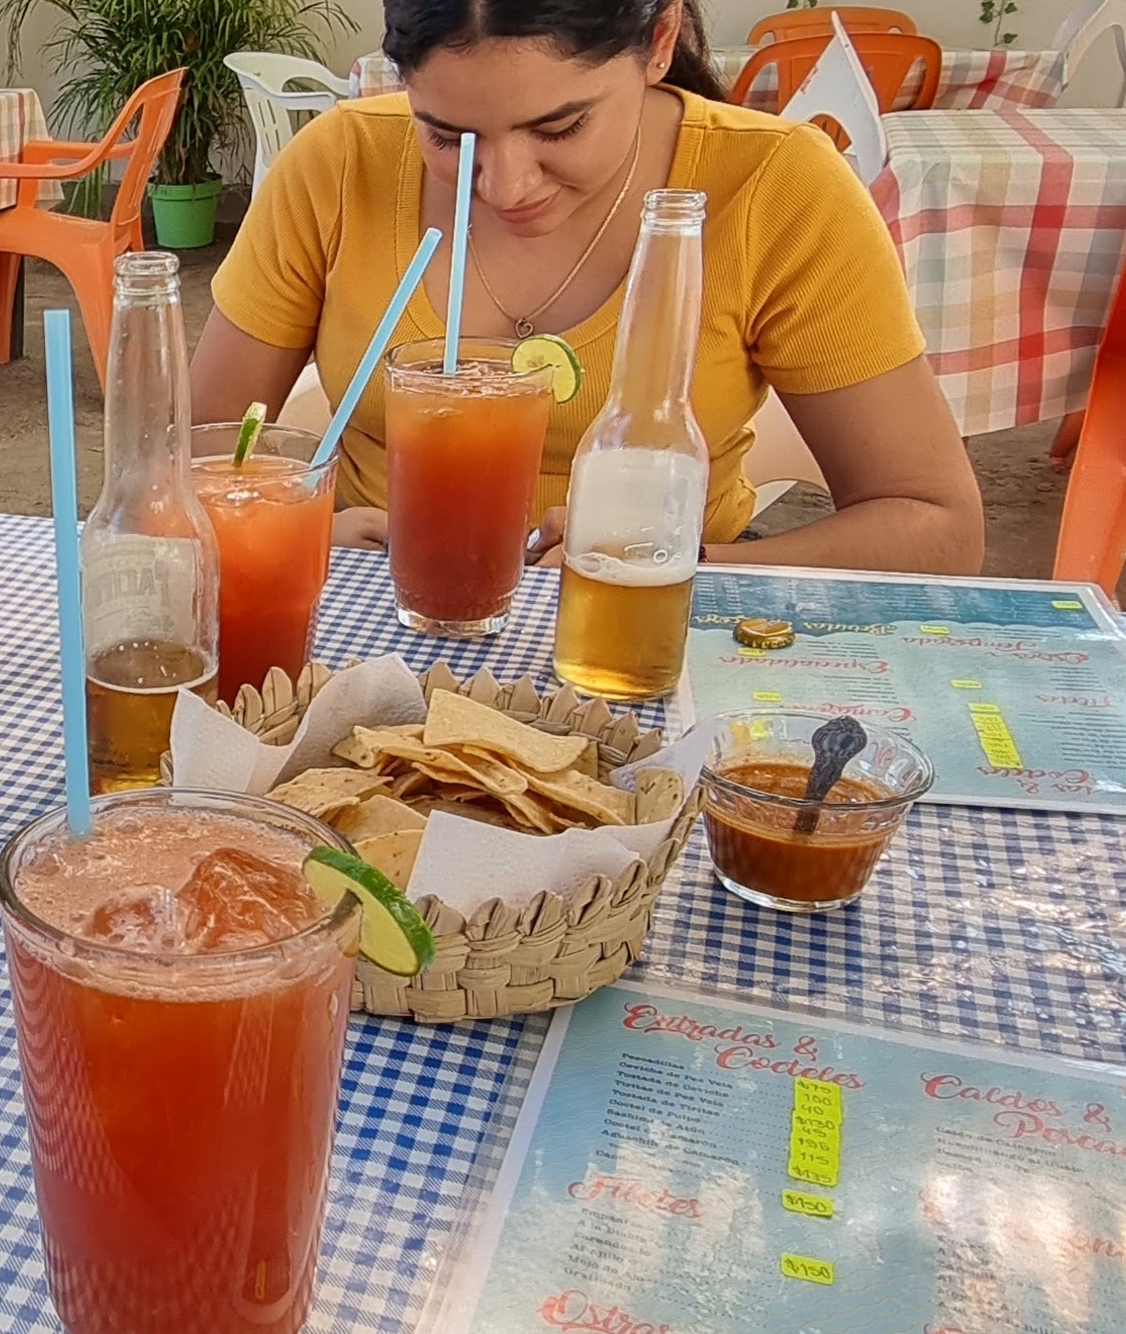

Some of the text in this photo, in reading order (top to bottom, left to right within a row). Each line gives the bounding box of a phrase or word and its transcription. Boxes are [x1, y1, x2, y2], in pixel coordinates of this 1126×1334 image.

[624, 1002, 818, 1061] Entradas &
[617, 1070, 662, 1085] Tostada
[665, 1079, 680, 1088] de
[619, 1061, 664, 1075] Ceviche
[666, 1069, 681, 1079] de
[612, 1088, 658, 1104] Tostada
[661, 1098, 676, 1107] de
[656, 1088, 671, 1097] de
[648, 1106, 663, 1116] de
[920, 1071, 1112, 1134] Caldos &
